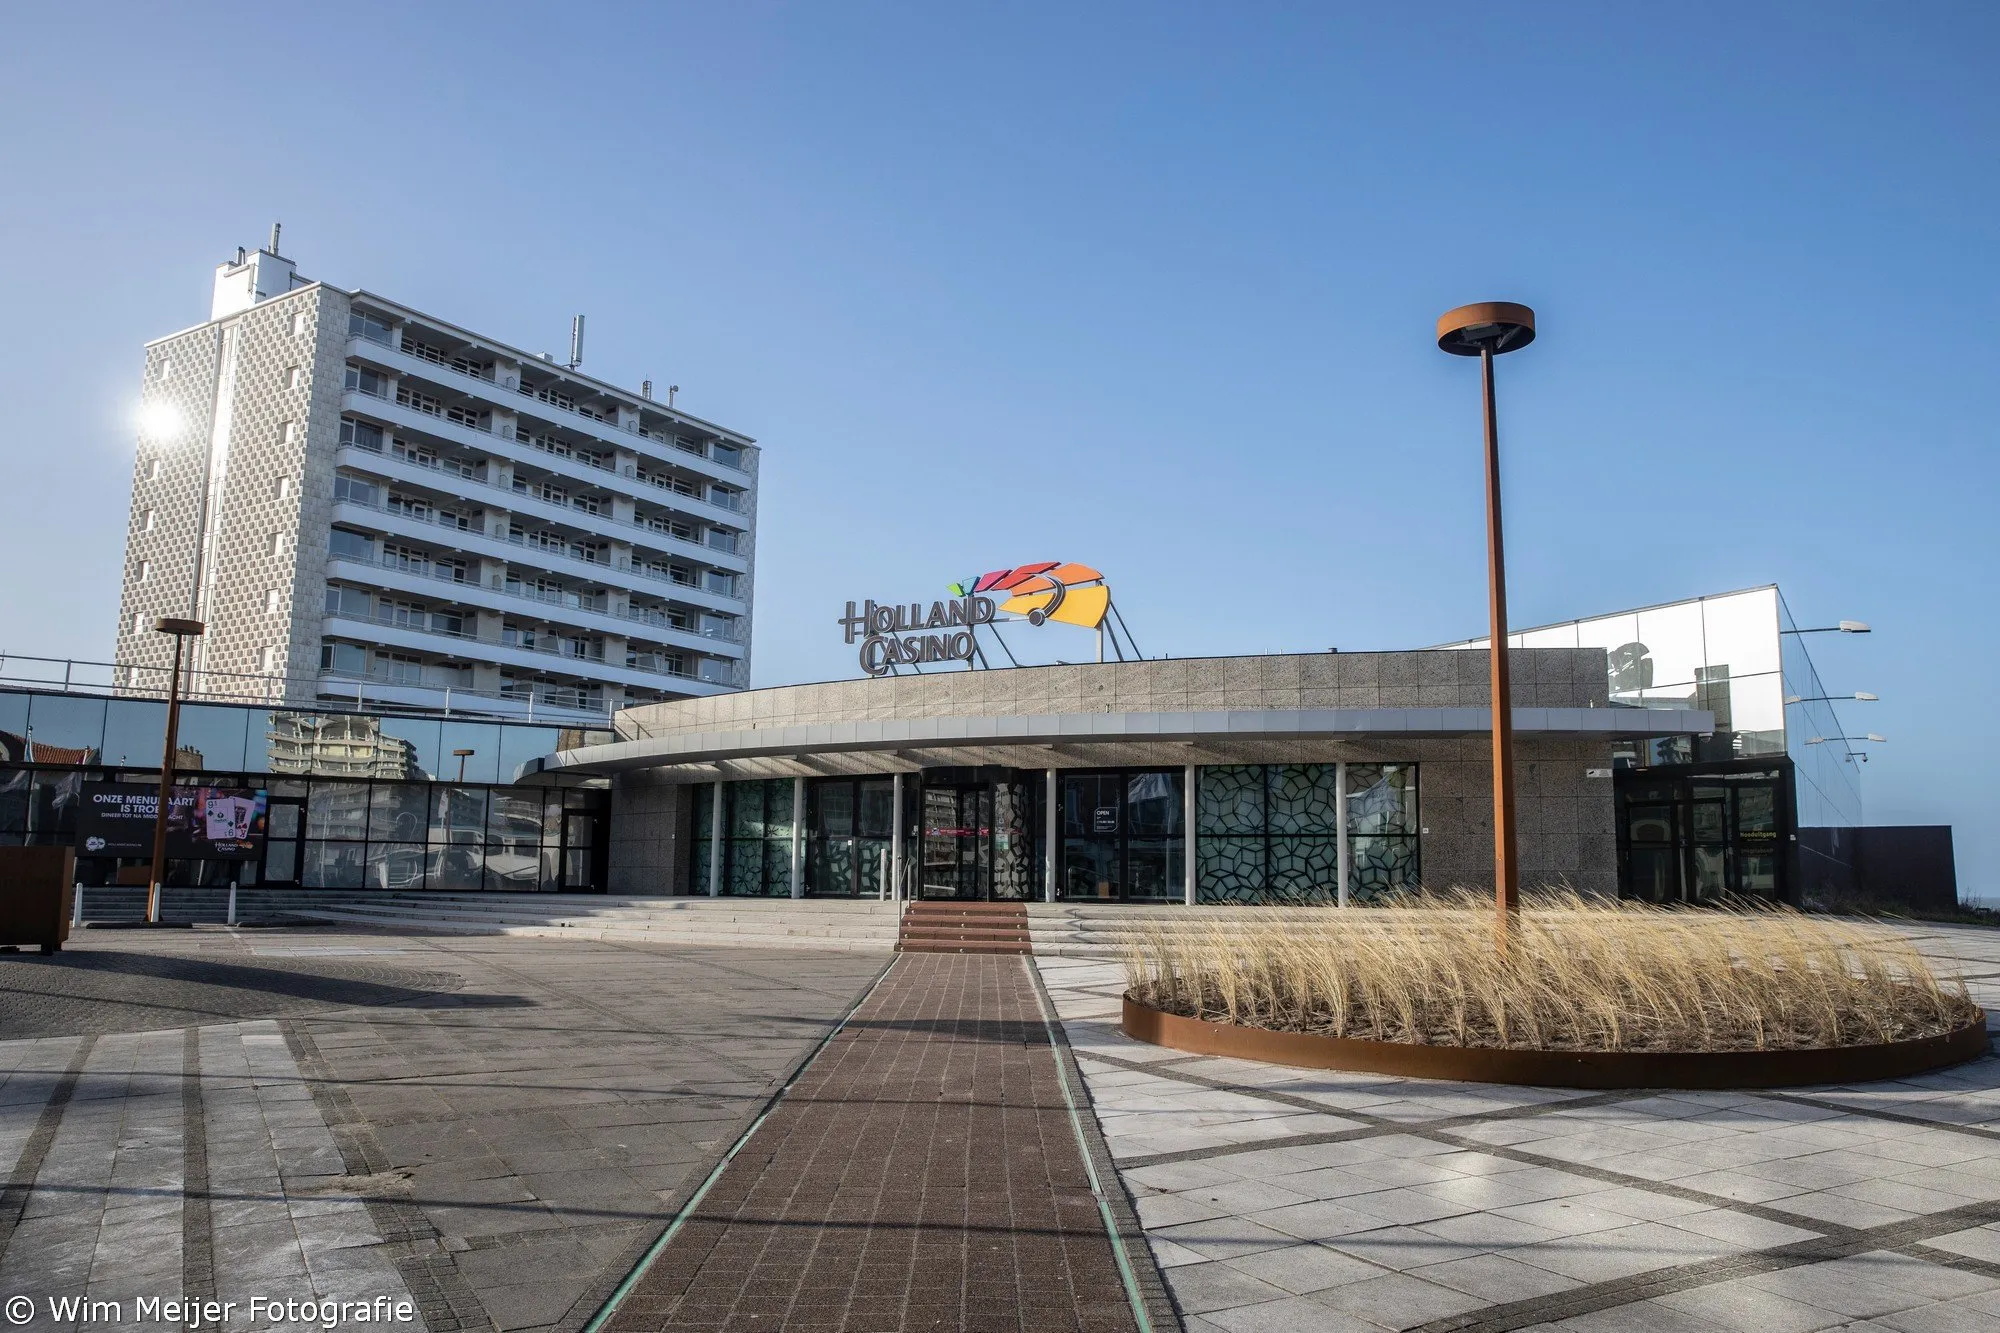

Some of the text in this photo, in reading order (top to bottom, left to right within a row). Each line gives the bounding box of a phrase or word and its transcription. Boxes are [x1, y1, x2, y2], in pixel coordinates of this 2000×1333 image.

[838, 596, 996, 644] HOLLAND
[859, 631, 976, 675] CASINO
[93, 794, 194, 806] ONZE MENUAART
[120, 804, 159, 814] IS TROE
